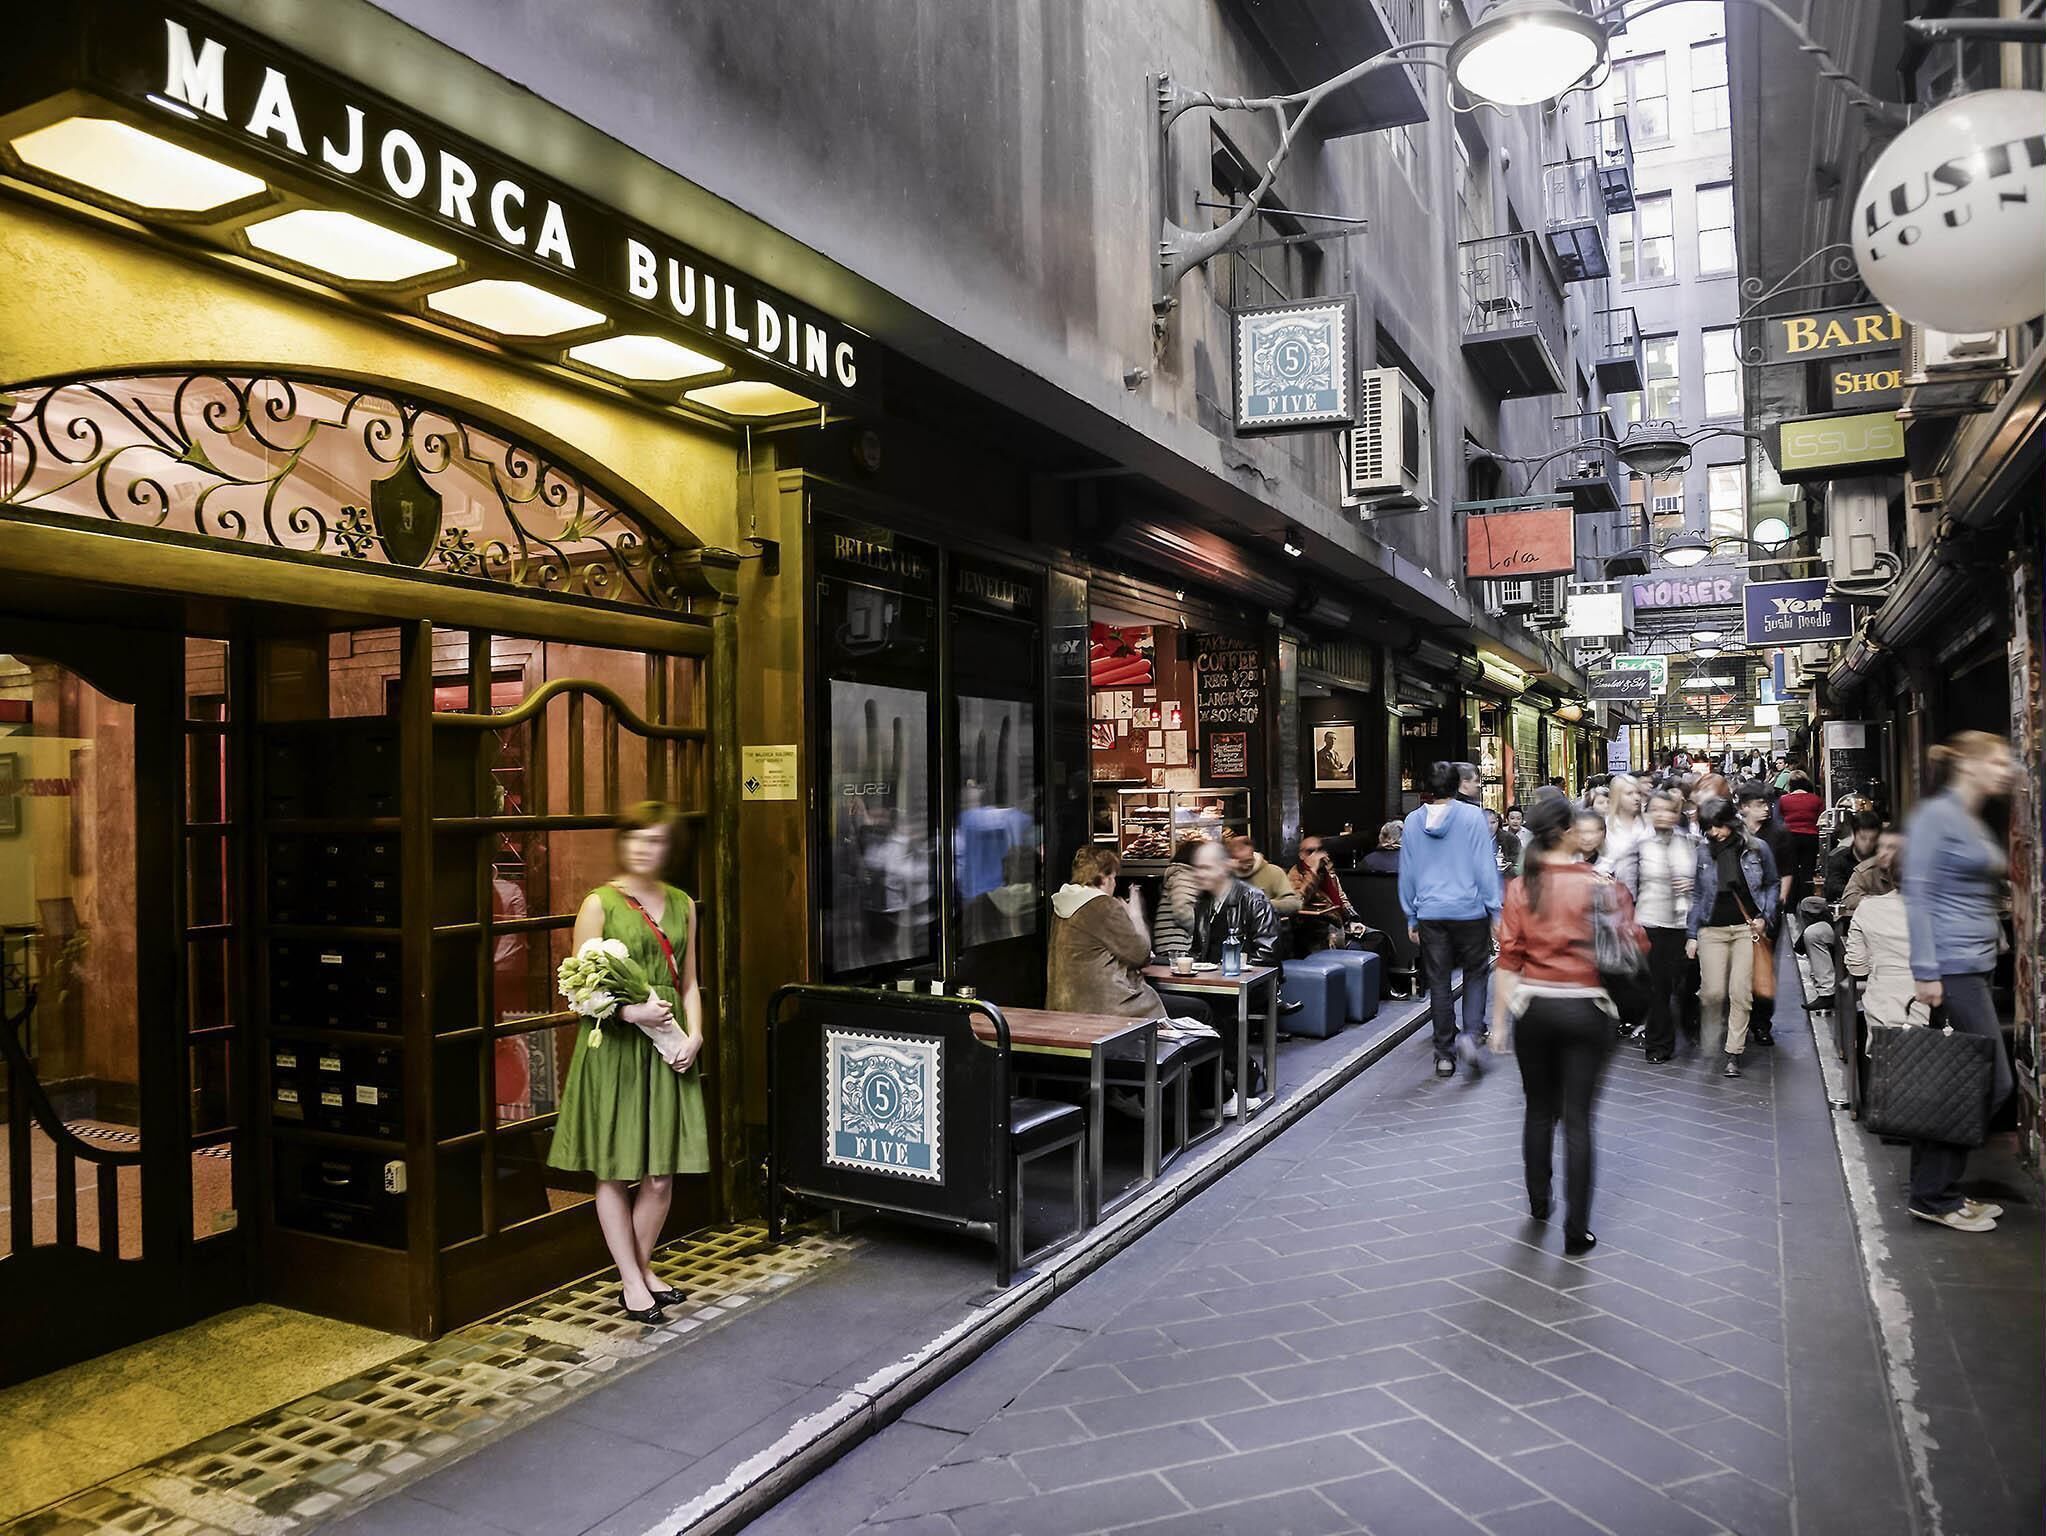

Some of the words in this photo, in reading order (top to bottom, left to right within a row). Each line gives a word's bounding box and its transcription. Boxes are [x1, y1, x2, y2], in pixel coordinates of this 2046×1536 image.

[165, 18, 577, 270] MAJORCA
[627, 237, 857, 388] BUILDING
[1285, 346, 1299, 372] 5
[1267, 392, 1317, 414] FIVE
[833, 534, 923, 580] BELLEVUE
[956, 568, 1032, 608] JEWELLERY
[1770, 598, 1823, 614] Yen
[1764, 615, 1793, 632] Sushi
[1197, 650, 1258, 672] COFFEE
[1203, 673, 1229, 689] REG
[1199, 691, 1236, 707] LARGE
[1210, 708, 1234, 722] SOY
[875, 1080, 890, 1111] 5
[855, 1136, 909, 1165] FIVE
